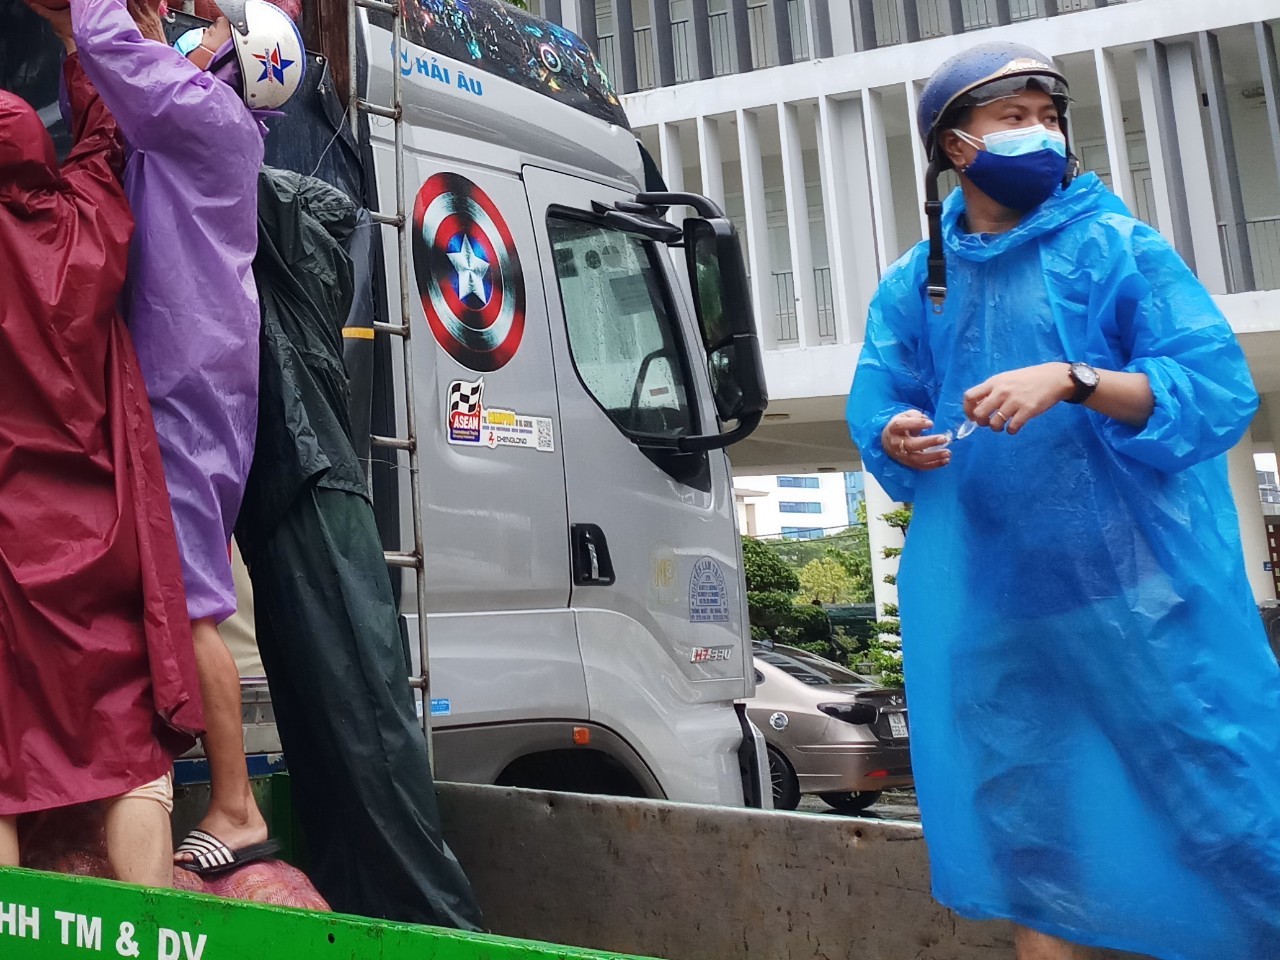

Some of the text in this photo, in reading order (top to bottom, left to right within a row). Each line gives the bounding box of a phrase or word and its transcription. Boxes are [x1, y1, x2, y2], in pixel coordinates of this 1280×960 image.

[415, 56, 484, 97] HẢI ÂU
[453, 414, 479, 430] ASEAN
[54, 910, 102, 951] TM
[115, 921, 140, 957] &
[157, 927, 209, 960] DV
